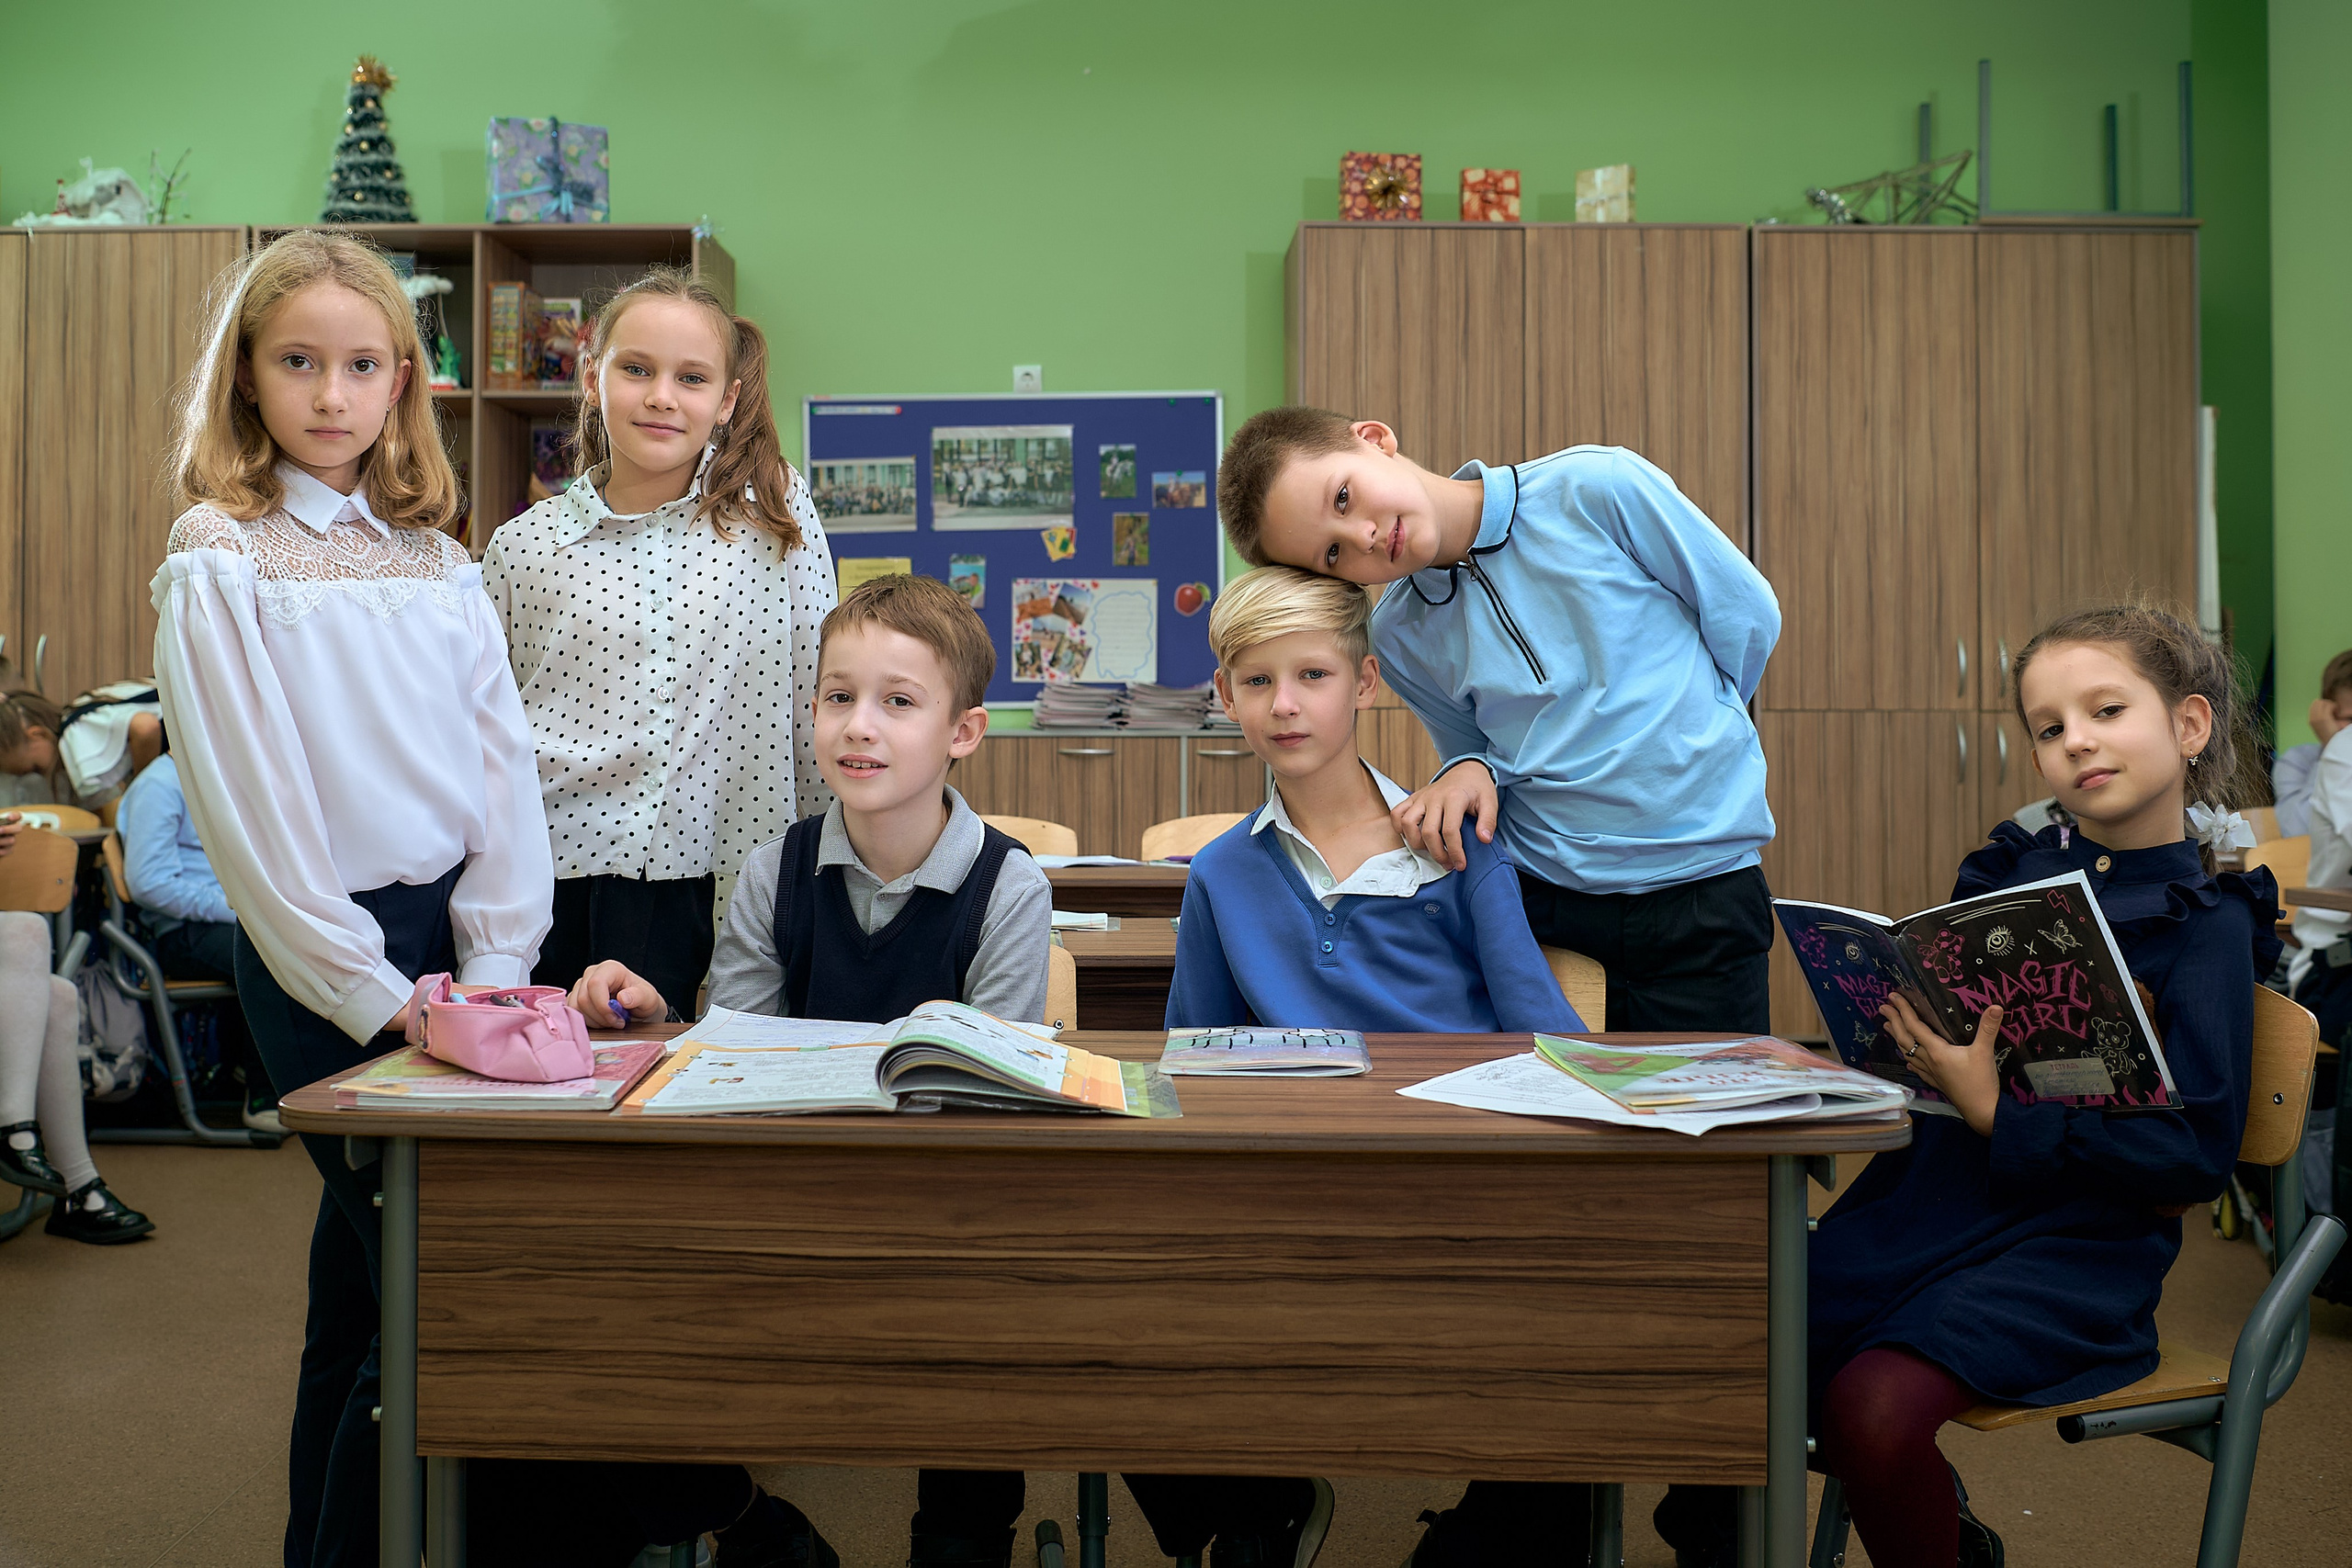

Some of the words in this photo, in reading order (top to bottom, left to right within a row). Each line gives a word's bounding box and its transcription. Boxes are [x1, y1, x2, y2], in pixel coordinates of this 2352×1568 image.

[1831, 973, 1894, 999] MAGI
[1947, 959, 2091, 1014] MAGIC
[1854, 997, 1886, 1020] GI
[1999, 999, 2087, 1047] GIRL
